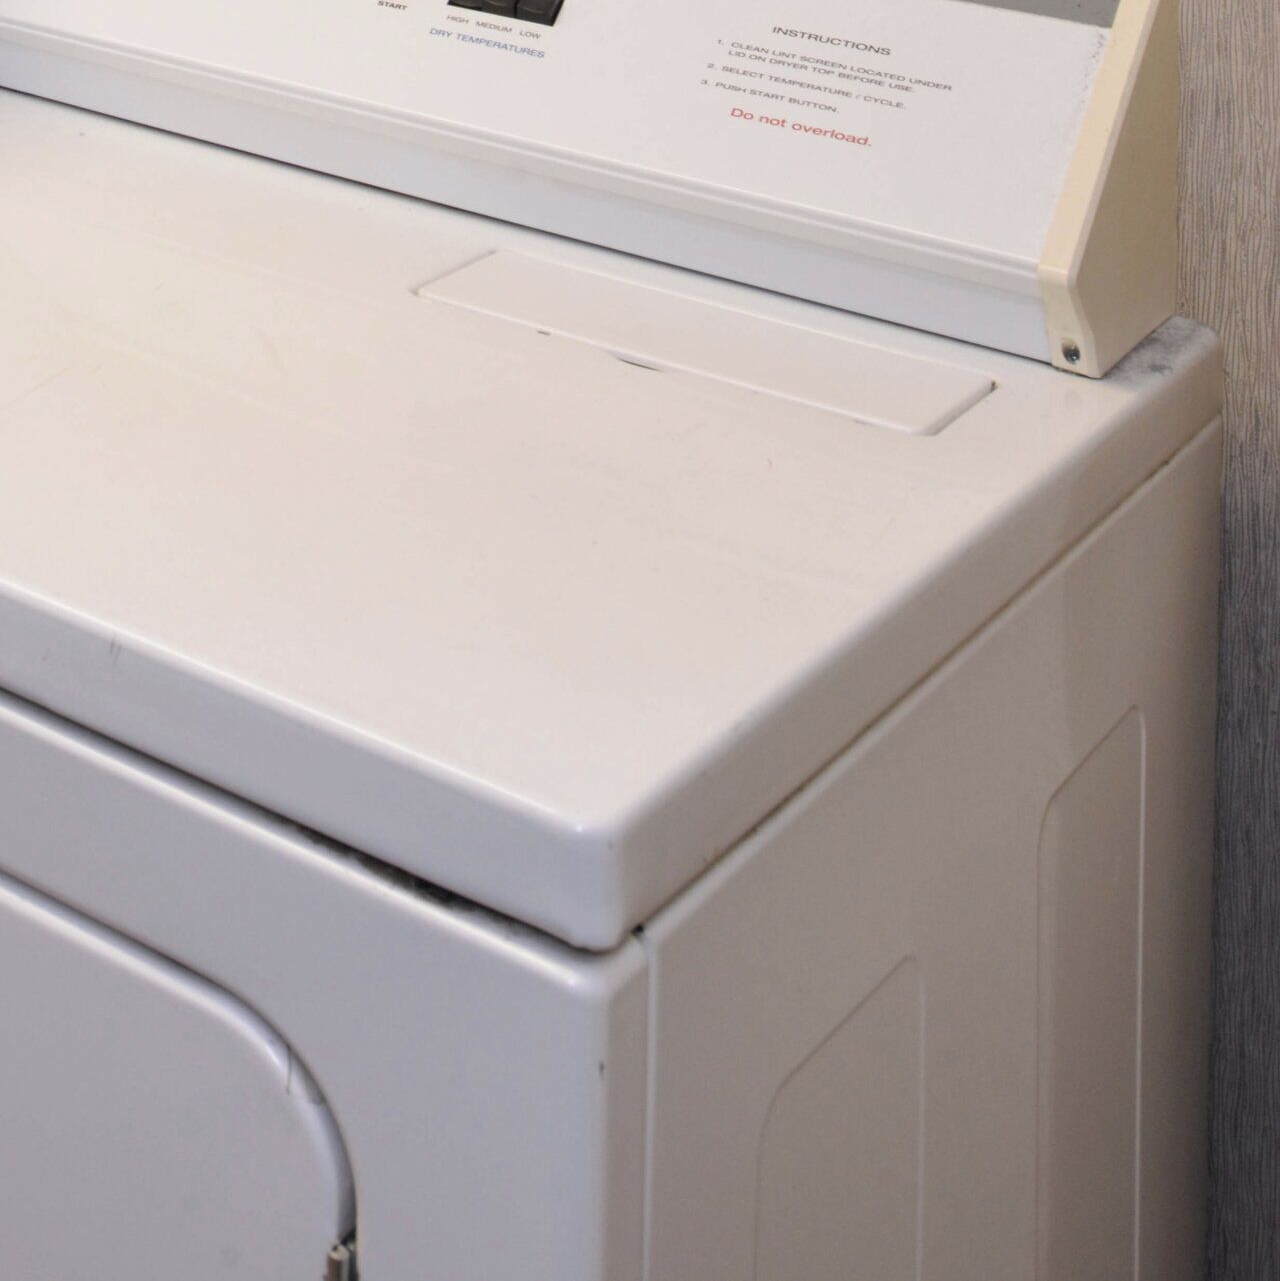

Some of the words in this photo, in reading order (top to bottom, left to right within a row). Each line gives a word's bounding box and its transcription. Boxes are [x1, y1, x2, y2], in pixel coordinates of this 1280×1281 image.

[377, 0, 407, 11] START
[429, 27, 453, 39] DRY
[456, 33, 546, 58] TEMPERATURES
[446, 15, 469, 24] HIGH
[475, 21, 512, 33] MEDIUM
[519, 30, 542, 39] LOW
[772, 26, 891, 56] INSTRUCTIONS
[728, 50, 746, 58] LID
[749, 54, 767, 63] ON
[769, 58, 808, 71] DRYER
[811, 66, 835, 76] TOP
[838, 72, 885, 87] BEFORE
[888, 82, 916, 93] USE.
[731, 41, 769, 54] CLEAN
[772, 50, 797, 60] LINT
[799, 55, 847, 70] SCREEN
[850, 65, 906, 82] LOCATED
[909, 77, 953, 91] UNDER
[715, 82, 747, 94] PUSH
[749, 89, 786, 102] START
[788, 97, 839, 114] BUTTON.
[721, 65, 765, 79] SELECT
[768, 75, 853, 98] TEMPERATURE
[863, 95, 907, 110] CYCLE.
[731, 107, 754, 120] Do
[759, 114, 787, 128] not
[791, 121, 872, 147] overload.
